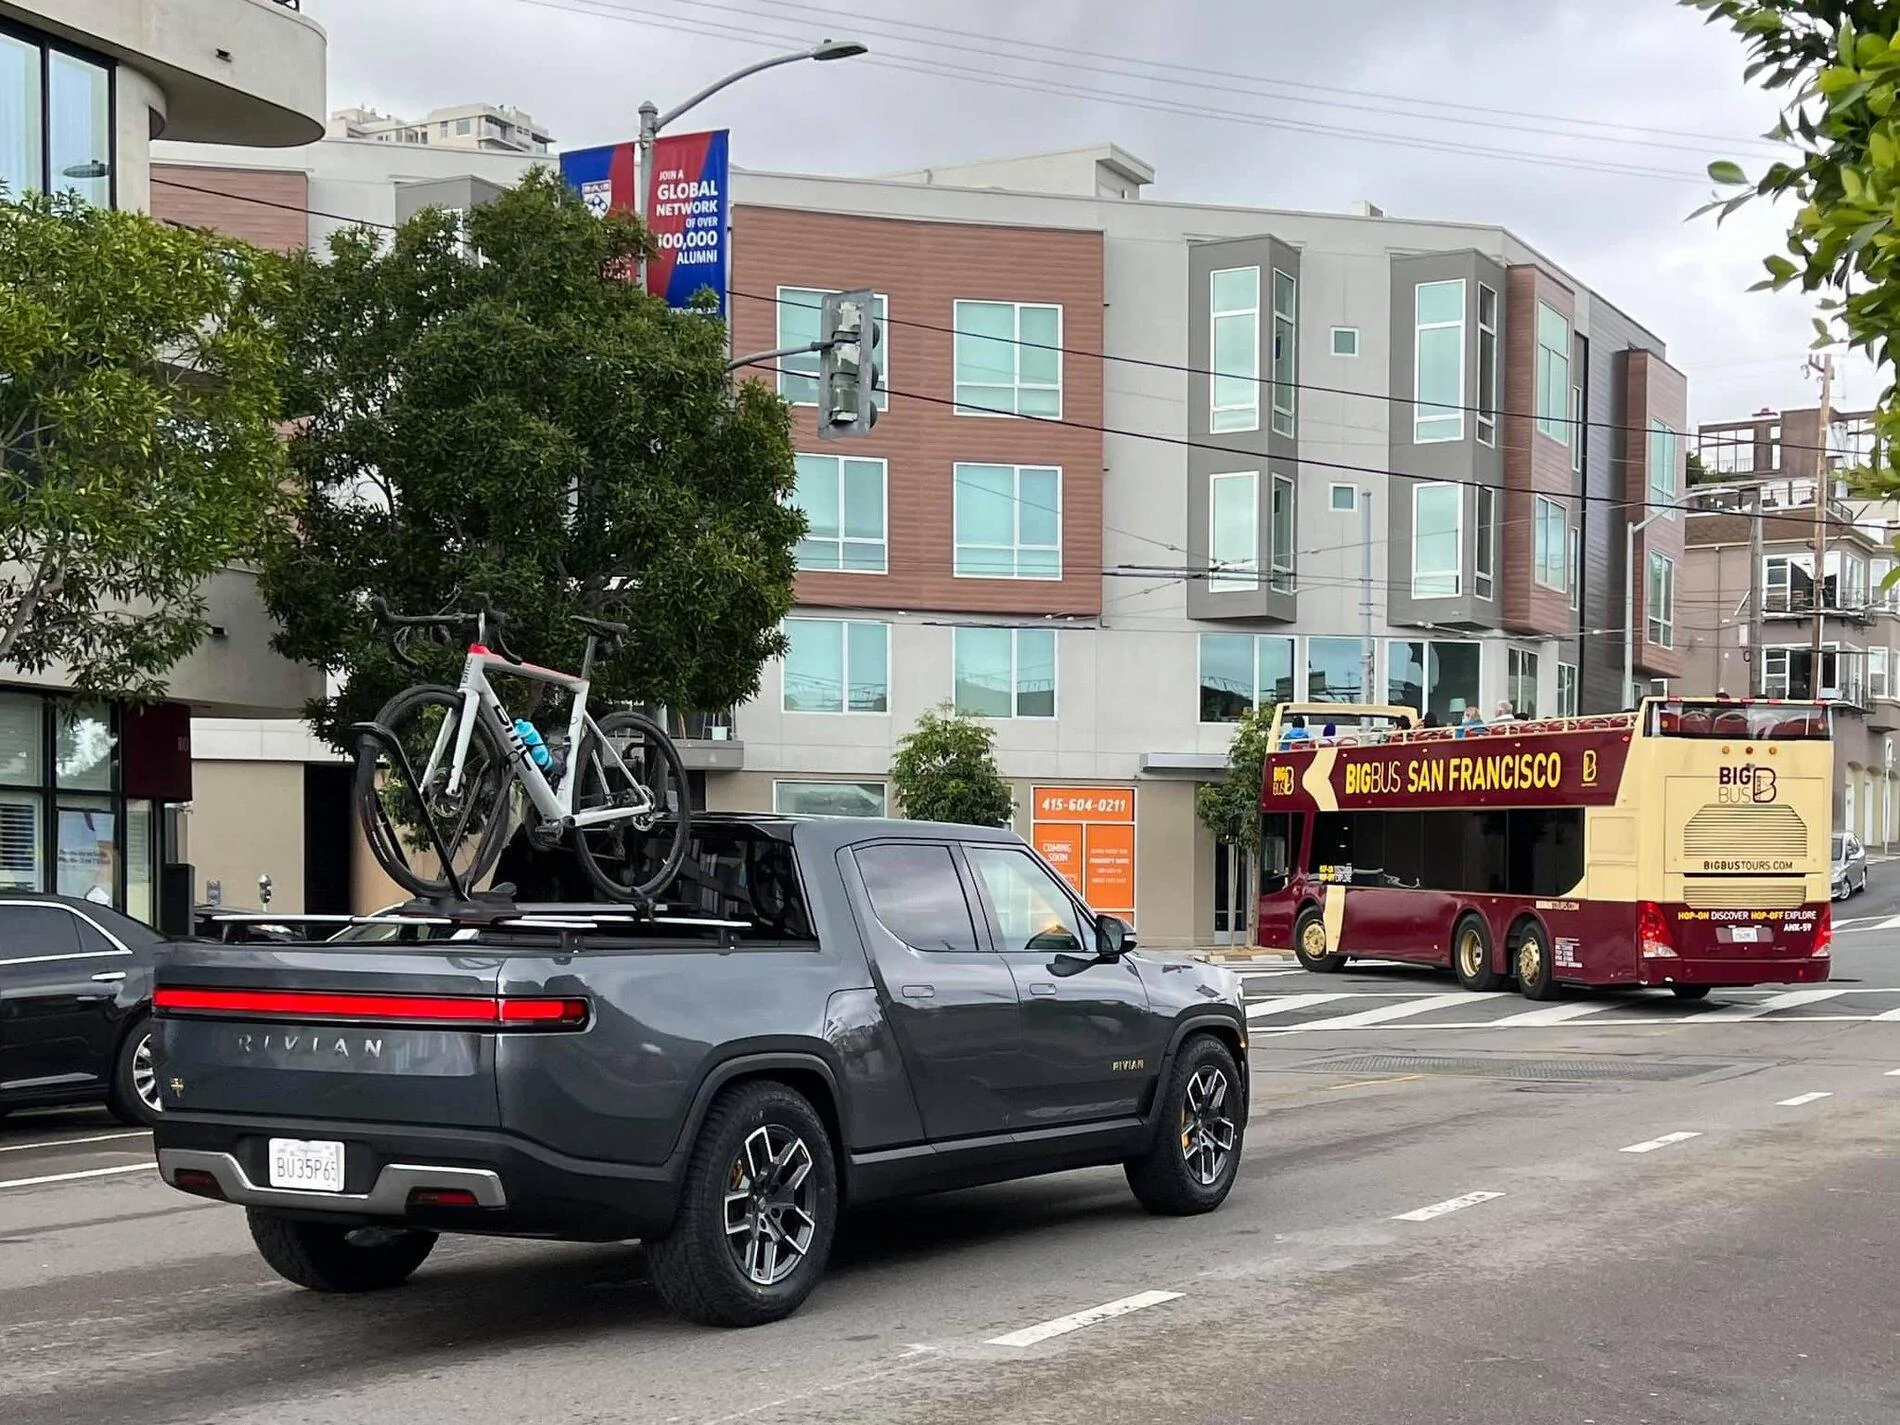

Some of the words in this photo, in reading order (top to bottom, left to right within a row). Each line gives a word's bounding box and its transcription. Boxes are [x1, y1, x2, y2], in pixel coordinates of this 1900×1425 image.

[658, 171, 677, 181] JOIN
[677, 169, 684, 179] A
[657, 180, 718, 200] GLOBAL
[656, 201, 718, 216] NETWORK
[685, 219, 696, 228] OF
[697, 217, 718, 227] OVER
[676, 250, 718, 265] ALUMNI
[1345, 761, 1401, 795] BIGBUS
[1407, 759, 1444, 793] SAN
[1448, 752, 1562, 792] FRANCISCO
[1719, 766, 1752, 785] BIG
[1718, 786, 1752, 804] BUS
[1042, 797, 1127, 813] 415-604-0211
[1703, 860, 1794, 871] BIGBUSTOURS.COM
[1677, 911, 1710, 920] HOP-ON
[1711, 911, 1749, 920] DISCOVER
[1750, 911, 1784, 920] HOP-OFF
[1784, 911, 1817, 920] EXPLORE
[238, 1034, 383, 1058] RIVIAN
